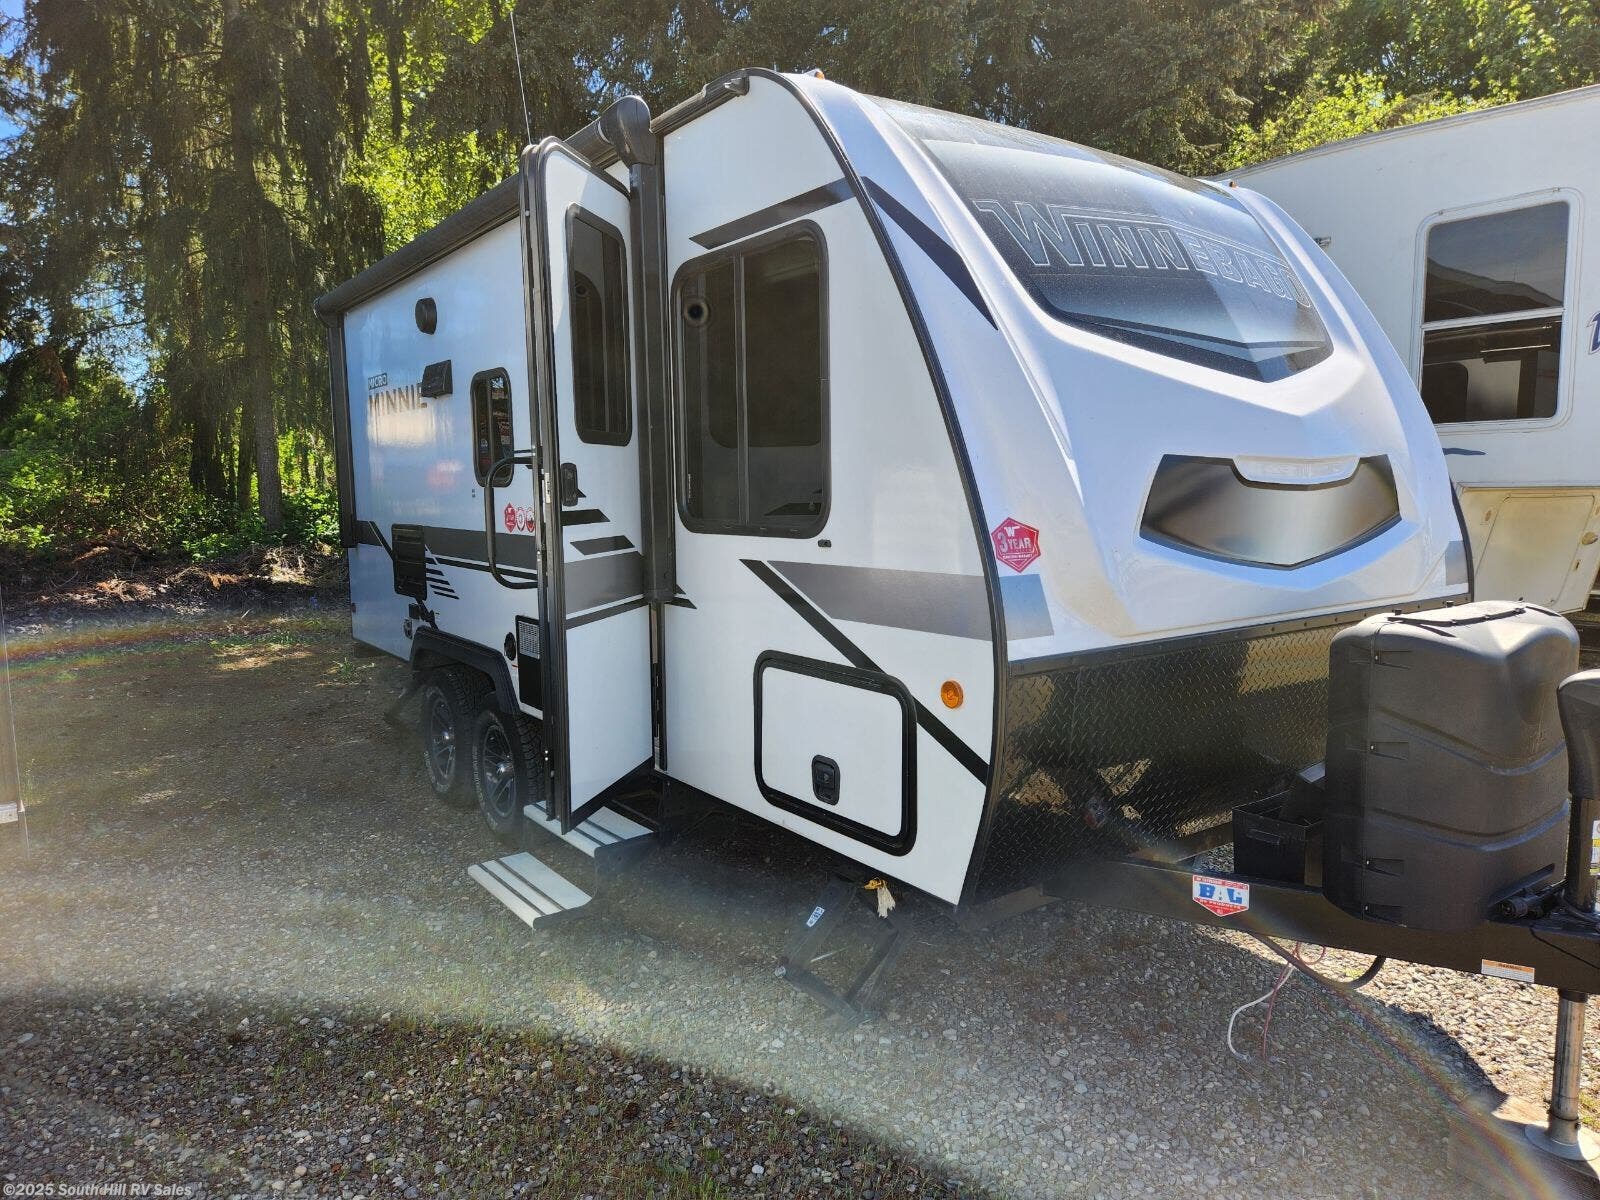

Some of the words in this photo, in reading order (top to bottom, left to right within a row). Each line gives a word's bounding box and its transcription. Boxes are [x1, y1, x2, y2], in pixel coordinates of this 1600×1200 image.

[972, 199, 1311, 308] WINNEBAGO
[1008, 537, 1031, 550] YEAR
[1199, 883, 1243, 904] BAL
